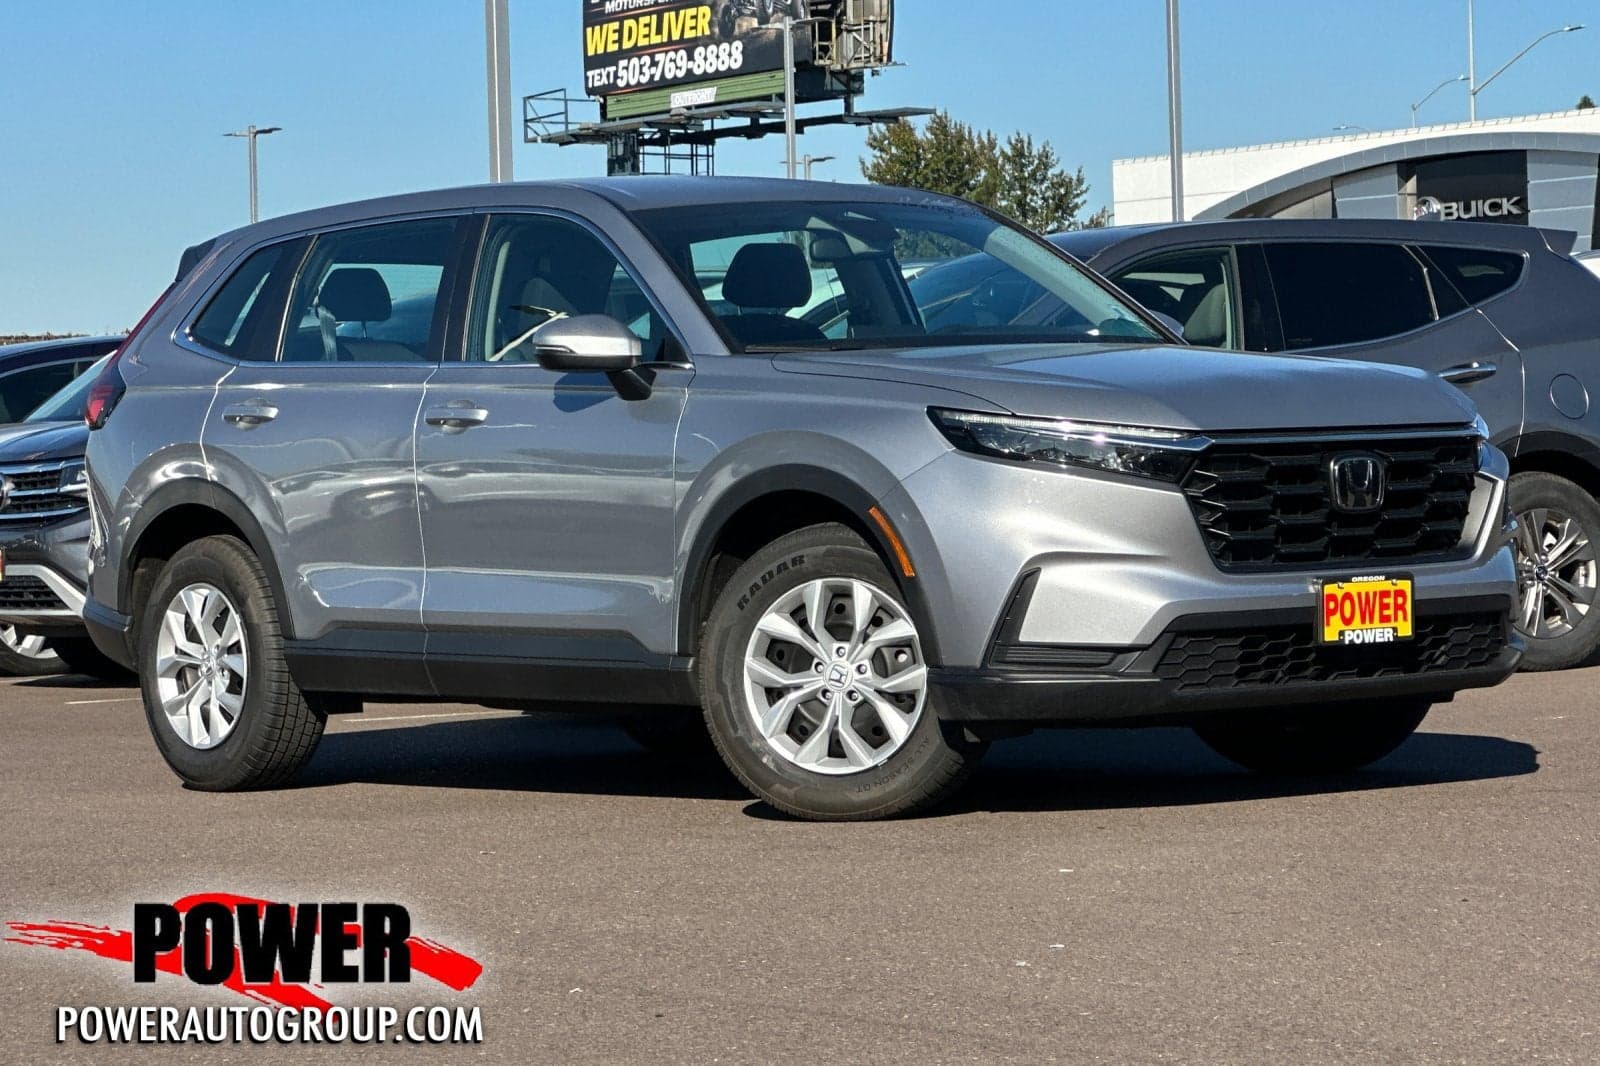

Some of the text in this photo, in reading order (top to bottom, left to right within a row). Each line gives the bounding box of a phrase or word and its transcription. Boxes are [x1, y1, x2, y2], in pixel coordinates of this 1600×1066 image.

[586, 5, 711, 56] WE DELIVER
[586, 40, 743, 88] TEXT 503-769-8888
[1440, 196, 1523, 221] BUICK
[736, 554, 806, 611] RADAR
[1351, 575, 1386, 583] OREGON
[1324, 589, 1408, 627] POWER
[1344, 628, 1394, 645] POWER
